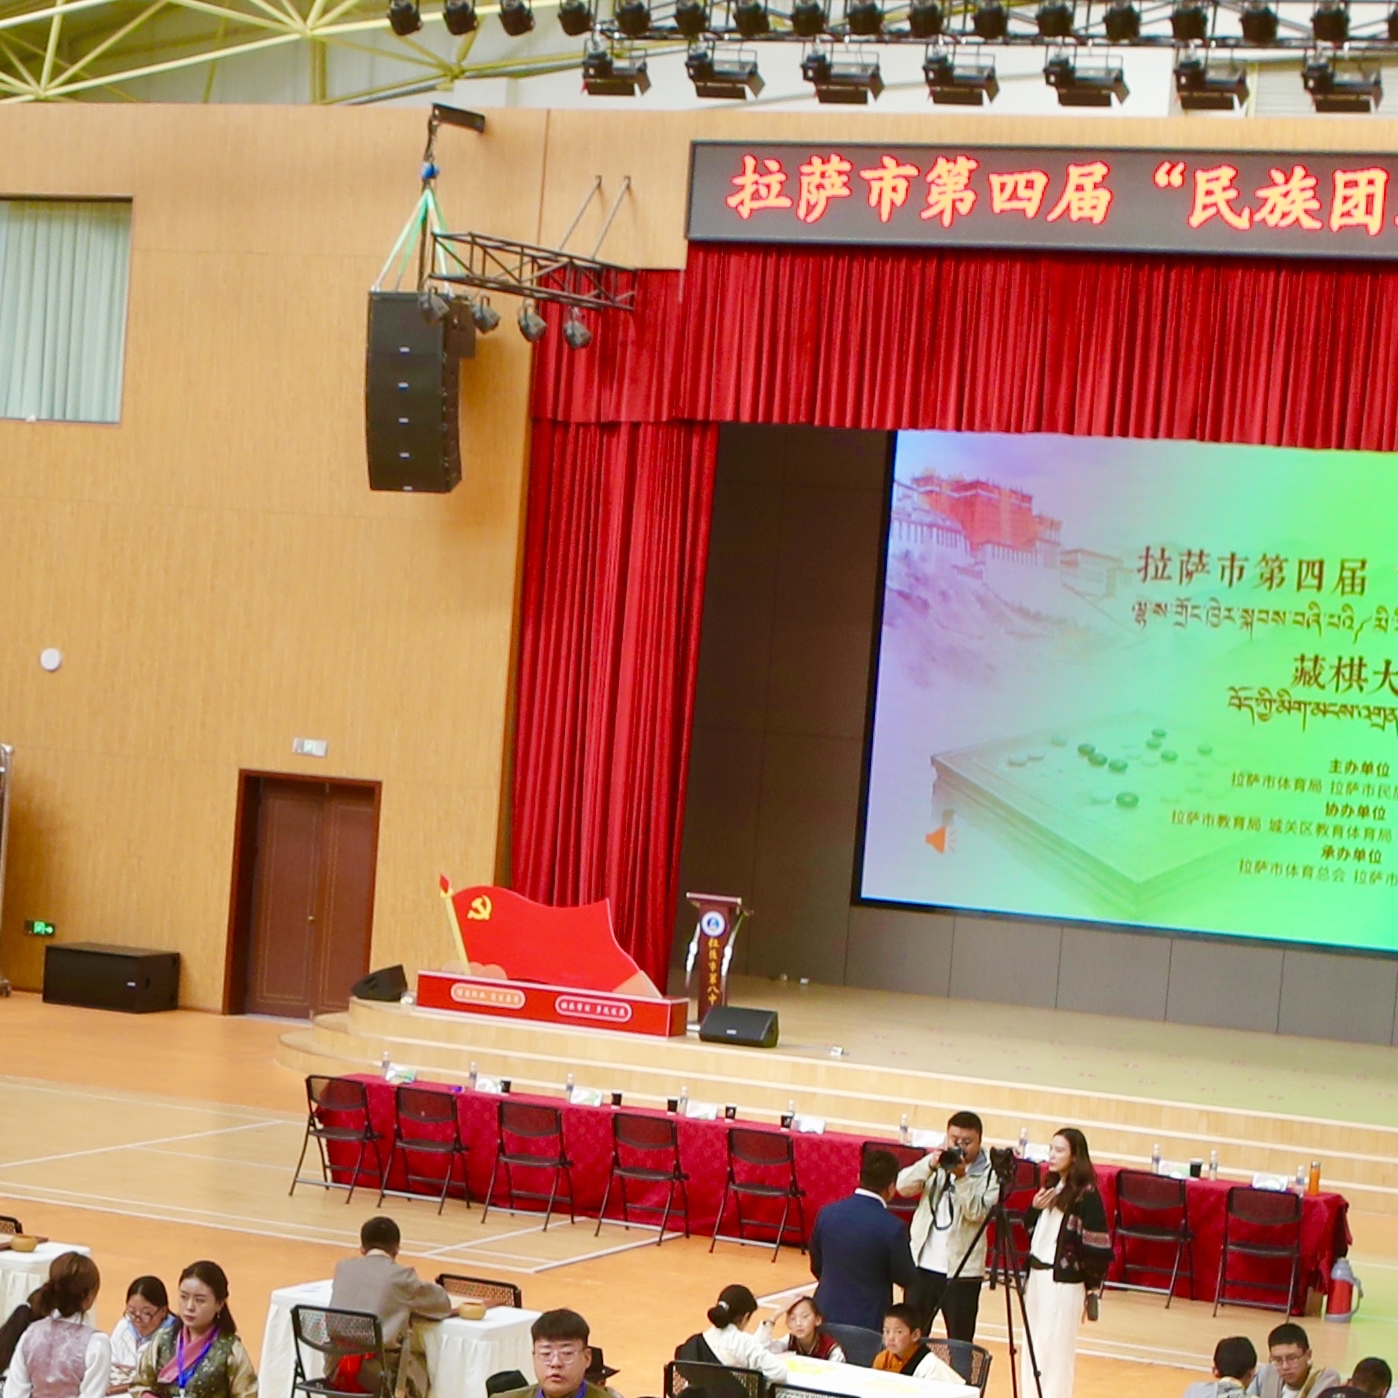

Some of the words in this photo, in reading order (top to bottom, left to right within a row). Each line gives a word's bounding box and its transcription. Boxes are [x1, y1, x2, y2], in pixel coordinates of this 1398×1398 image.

[726, 152, 1114, 228] 拉萨市第四届
[1136, 545, 1368, 597] 拉萨市第四届
[1329, 759, 1390, 777] 主办单位
[1231, 772, 1323, 794] 拉萨市体育局
[1172, 809, 1261, 833] 拉萨市教育局
[1325, 802, 1387, 821] 协办单位
[1321, 844, 1383, 864] 承办单位
